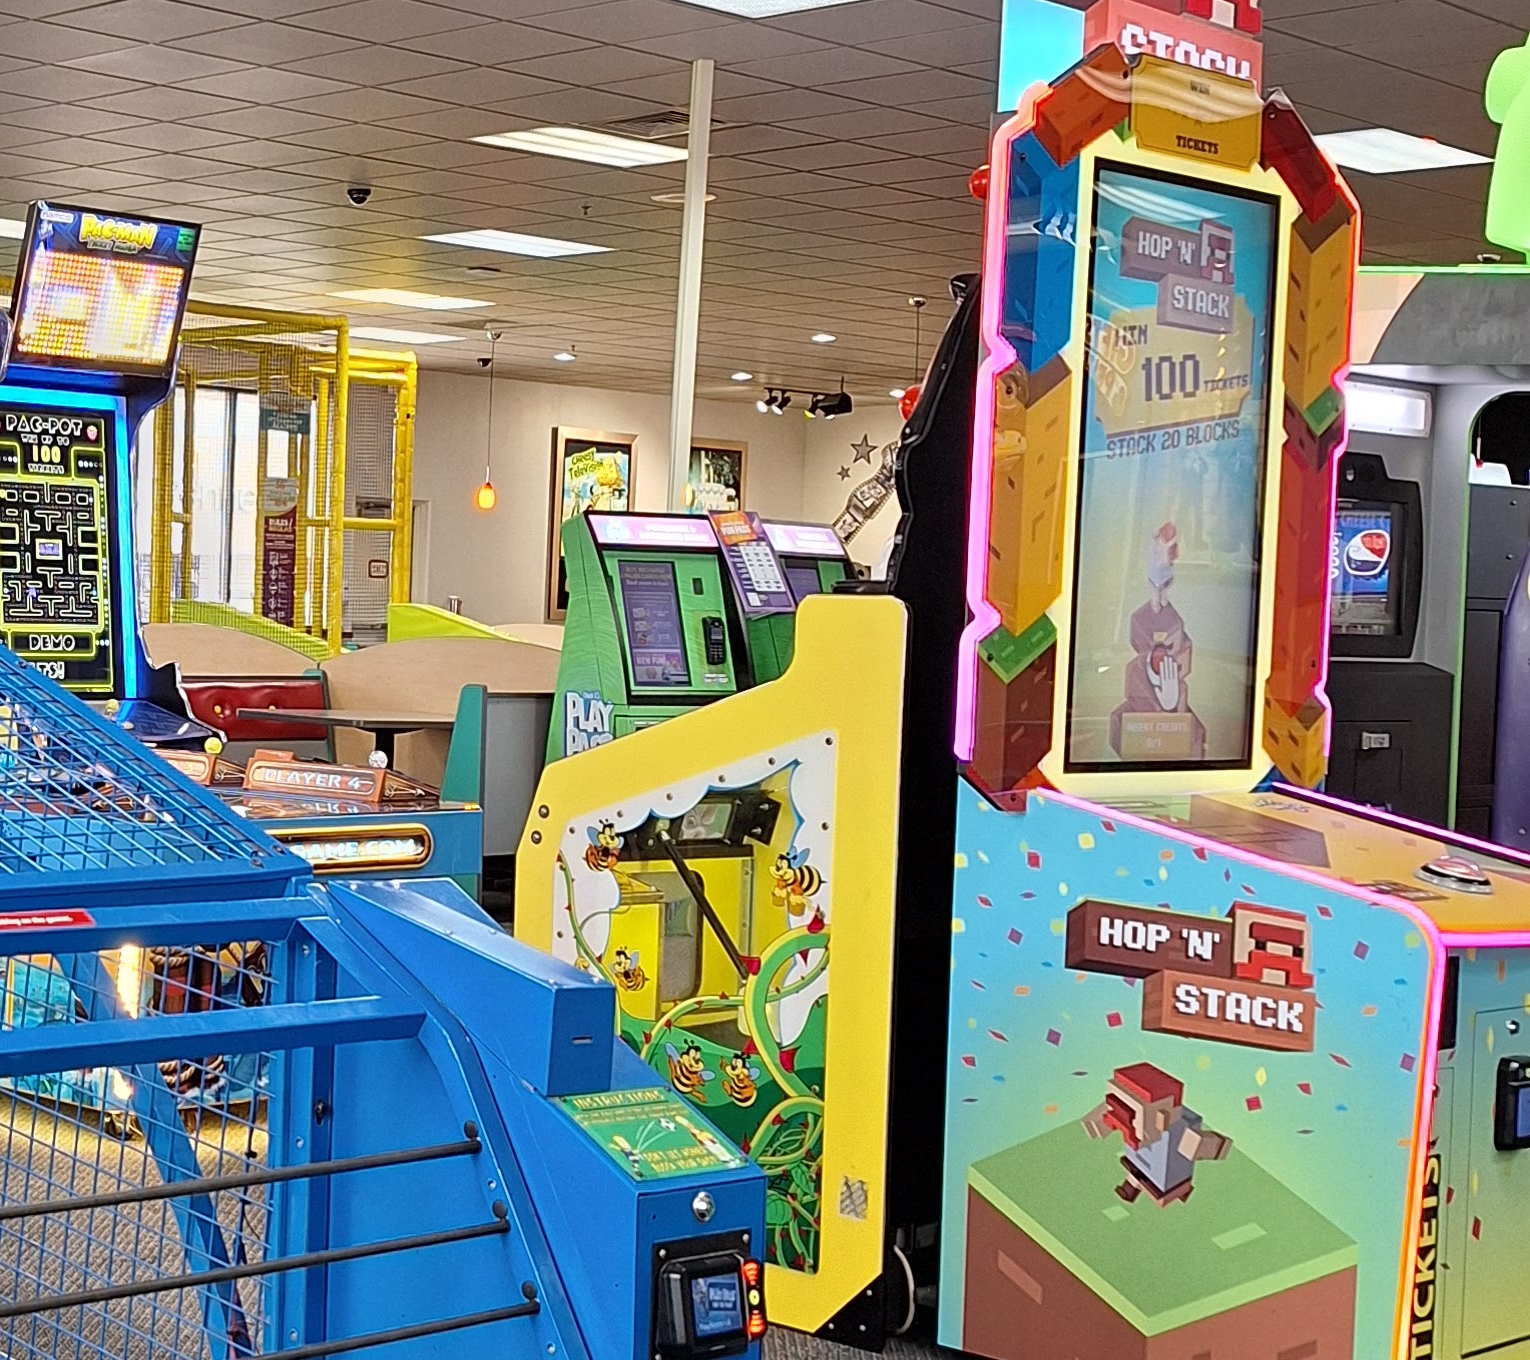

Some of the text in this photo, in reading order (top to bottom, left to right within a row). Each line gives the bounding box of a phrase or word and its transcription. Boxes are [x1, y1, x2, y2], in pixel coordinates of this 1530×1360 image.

[1175, 134, 1220, 156] TICKETS
[1137, 230, 1173, 260] HOP
[1172, 284, 1230, 319] STACK
[1115, 323, 1149, 347] WIN
[1142, 353, 1250, 402] 100 TICKETS
[5, 414, 83, 437] PAC-POT
[56, 436, 70, 446] TO
[1106, 419, 1241, 461] STACK 20 BLOCKS
[32, 444, 62, 464] 100
[28, 634, 76, 651] DEMO
[566, 691, 615, 733] PLAY
[263, 768, 342, 788] PLAYER
[1099, 916, 1171, 953] HOP
[1174, 983, 1304, 1034] STACK
